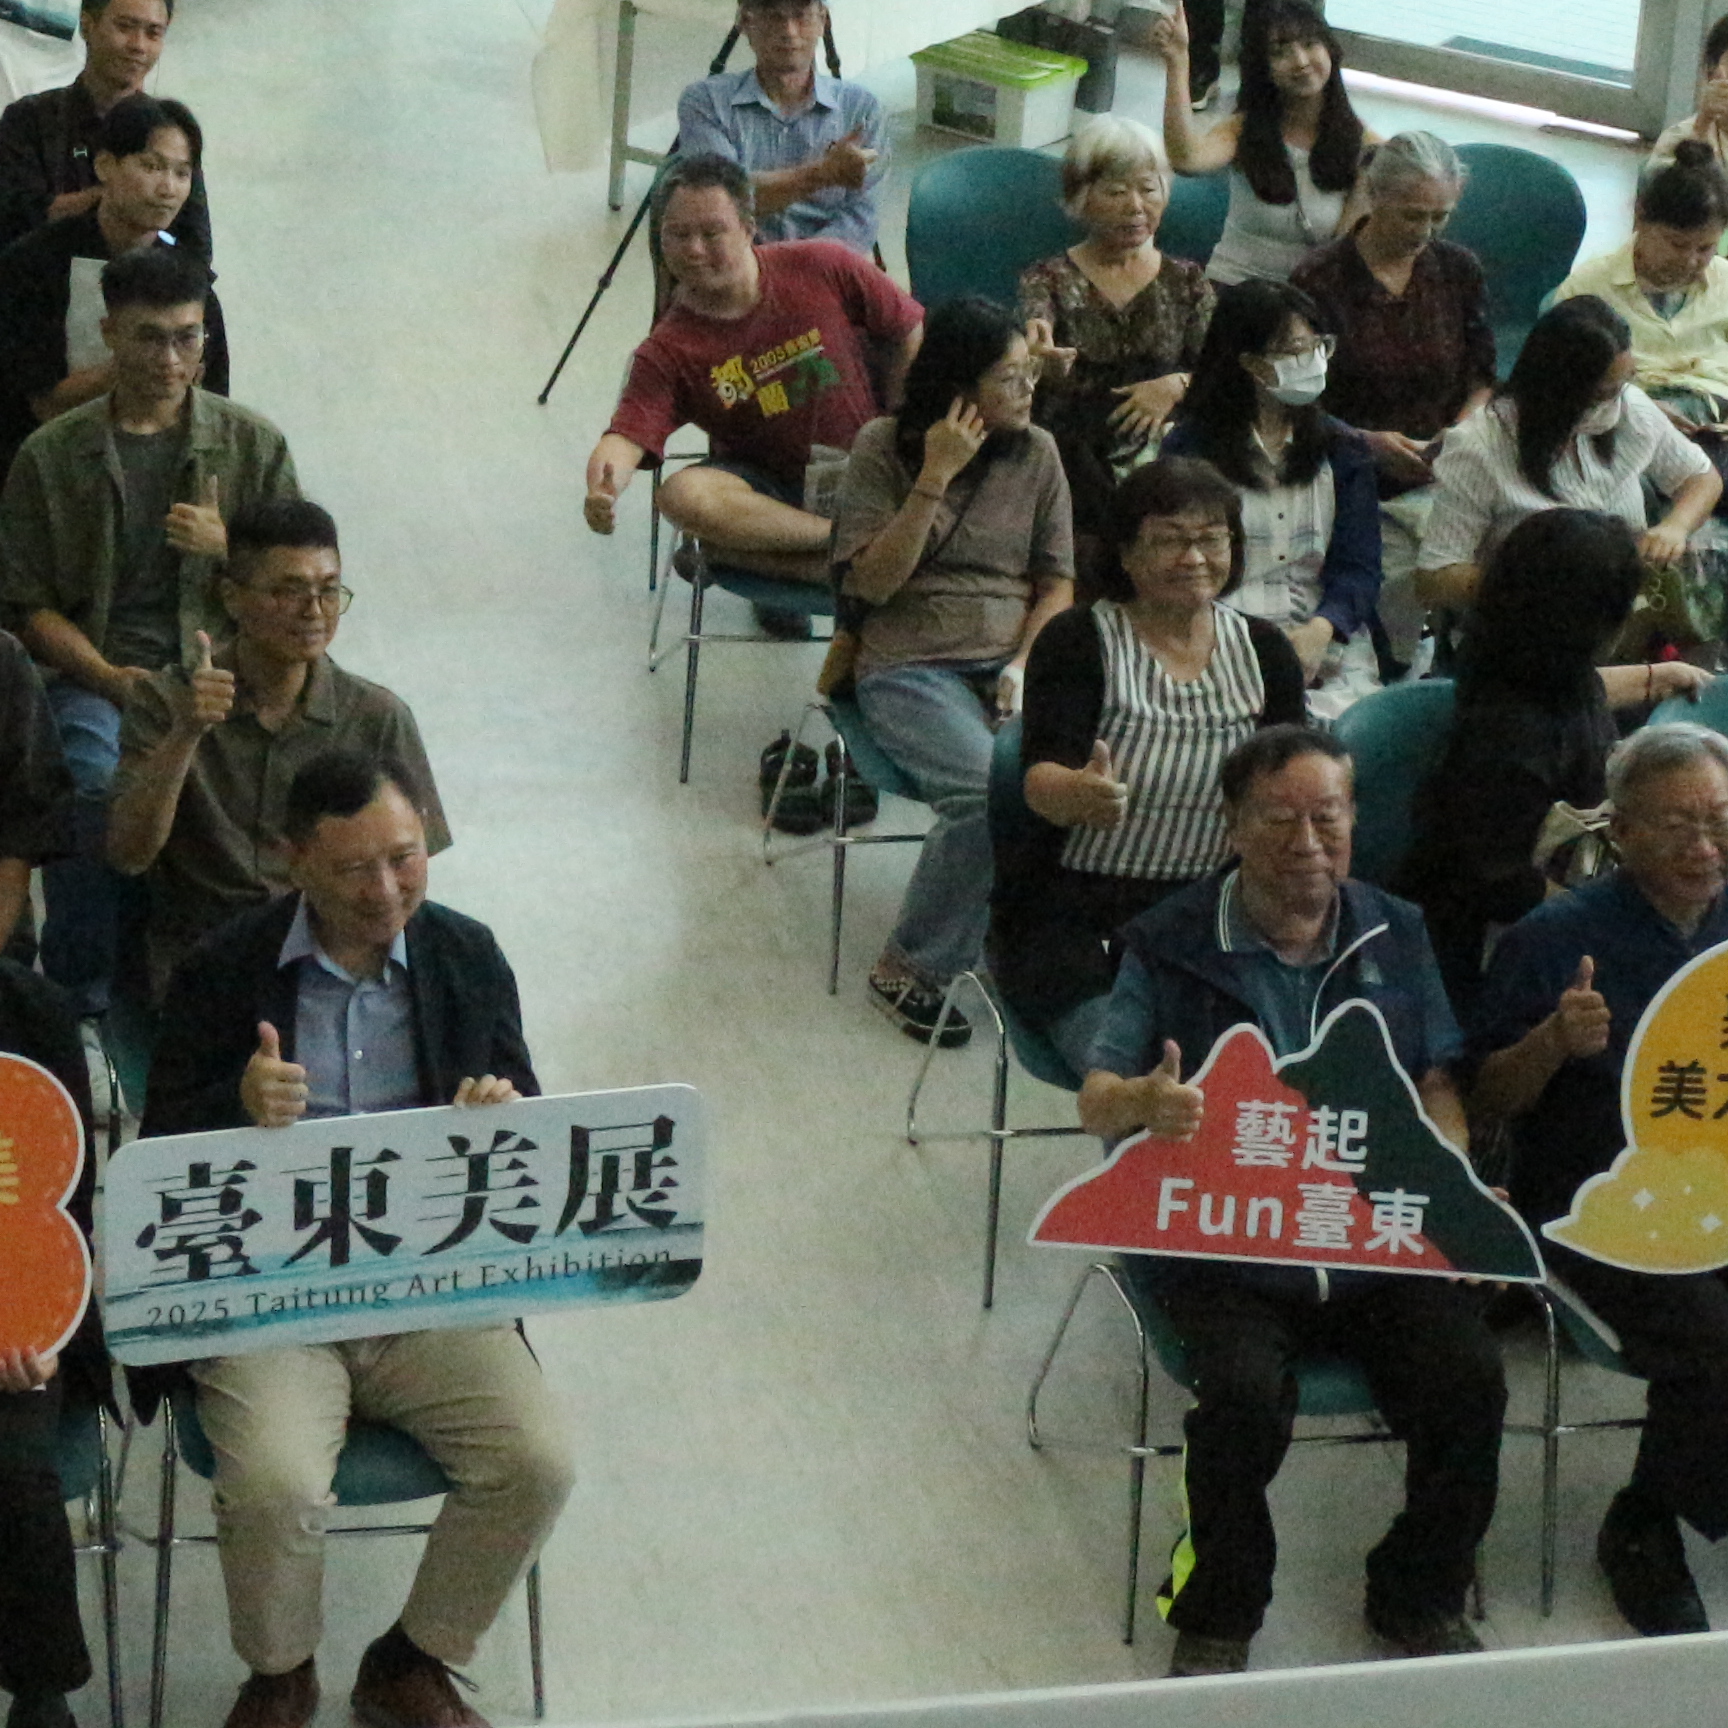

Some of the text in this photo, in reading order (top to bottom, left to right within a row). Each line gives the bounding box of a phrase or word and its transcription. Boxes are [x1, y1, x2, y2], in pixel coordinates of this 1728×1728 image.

[1231, 1099, 1369, 1172] 藝起
[135, 1114, 679, 1284] 臺東美展
[1157, 1177, 1430, 1255] Fun臺東
[147, 1247, 672, 1329] 2025 Taitung Art Exhibition
